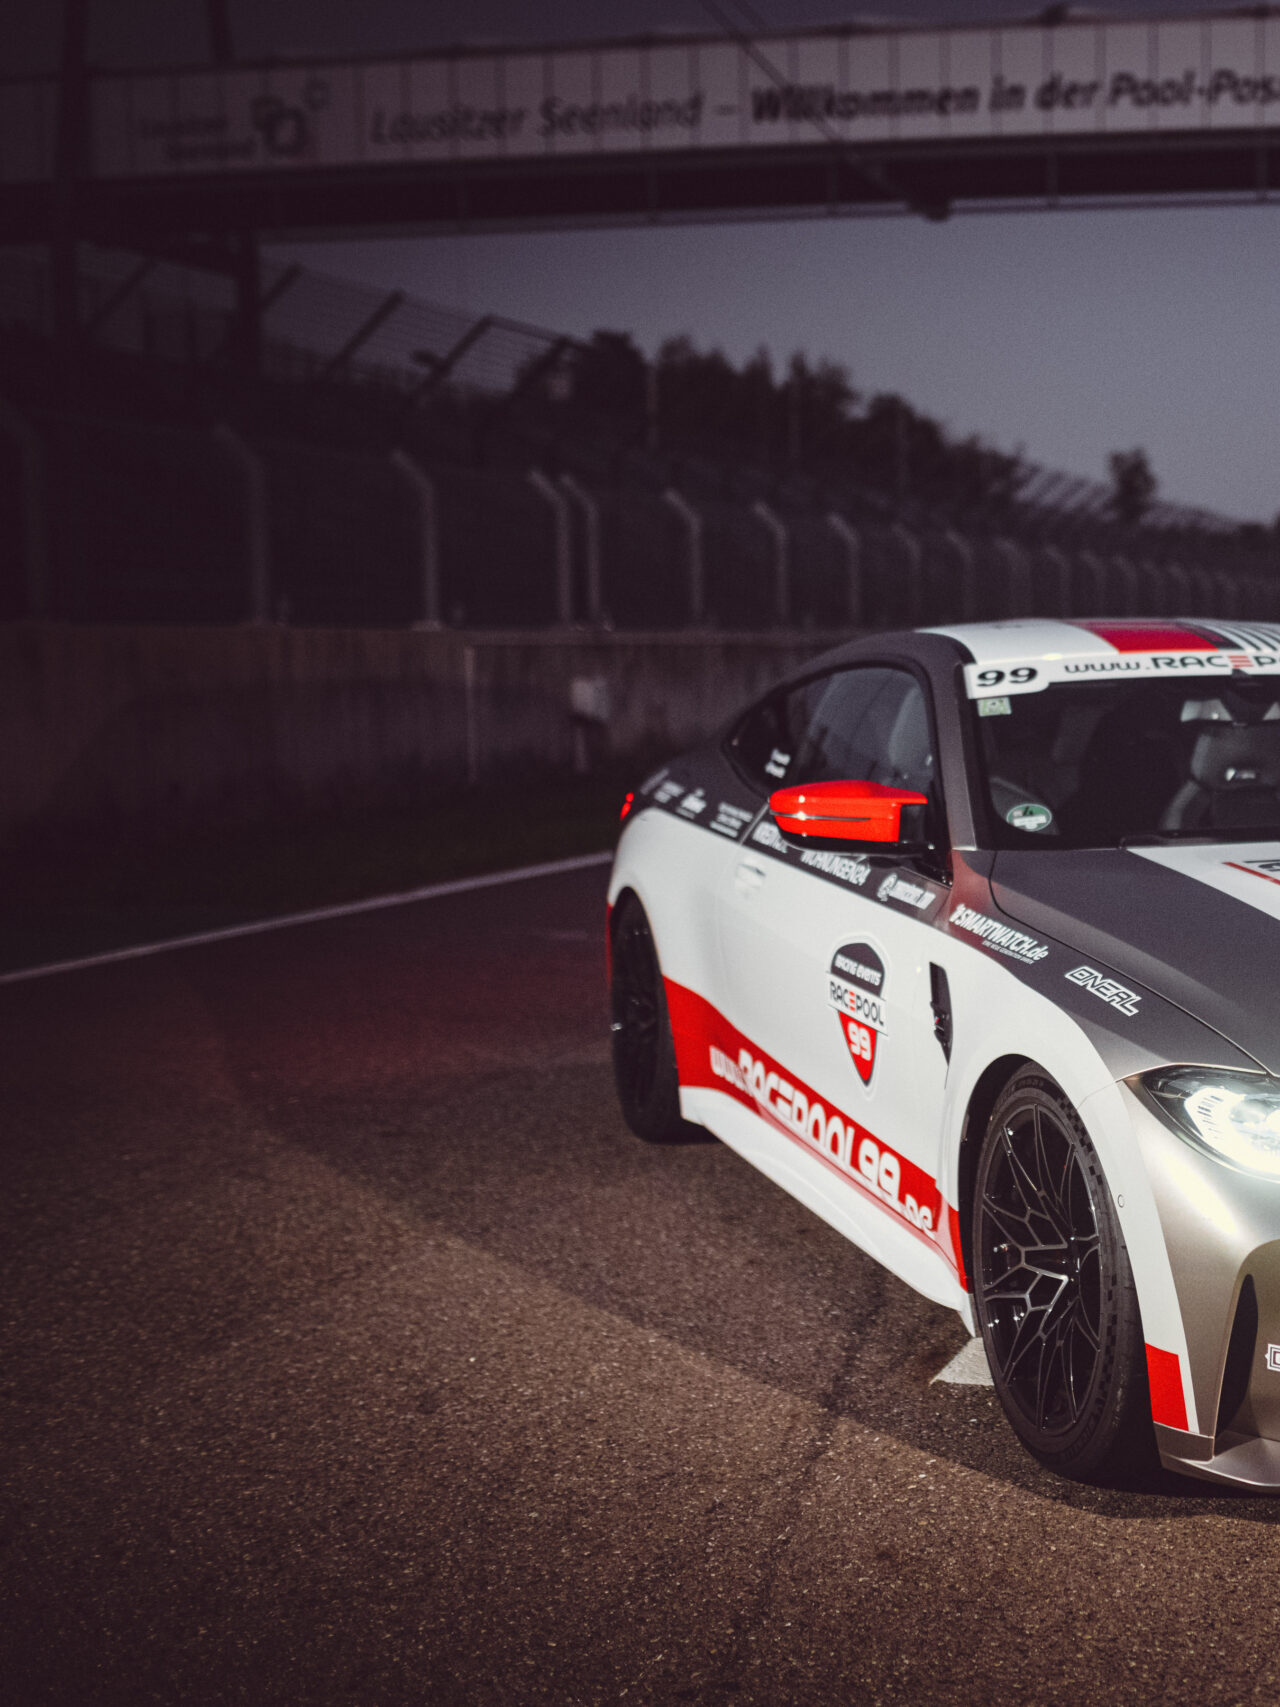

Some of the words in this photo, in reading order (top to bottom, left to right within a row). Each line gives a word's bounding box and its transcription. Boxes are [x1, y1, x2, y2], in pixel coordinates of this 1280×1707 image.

[538, 90, 705, 137] Seenland
[988, 73, 1026, 111] in
[1035, 70, 1098, 110] der
[976, 667, 1038, 687] 99
[829, 981, 884, 1027] RACEPOOL
[847, 1021, 872, 1062] 99
